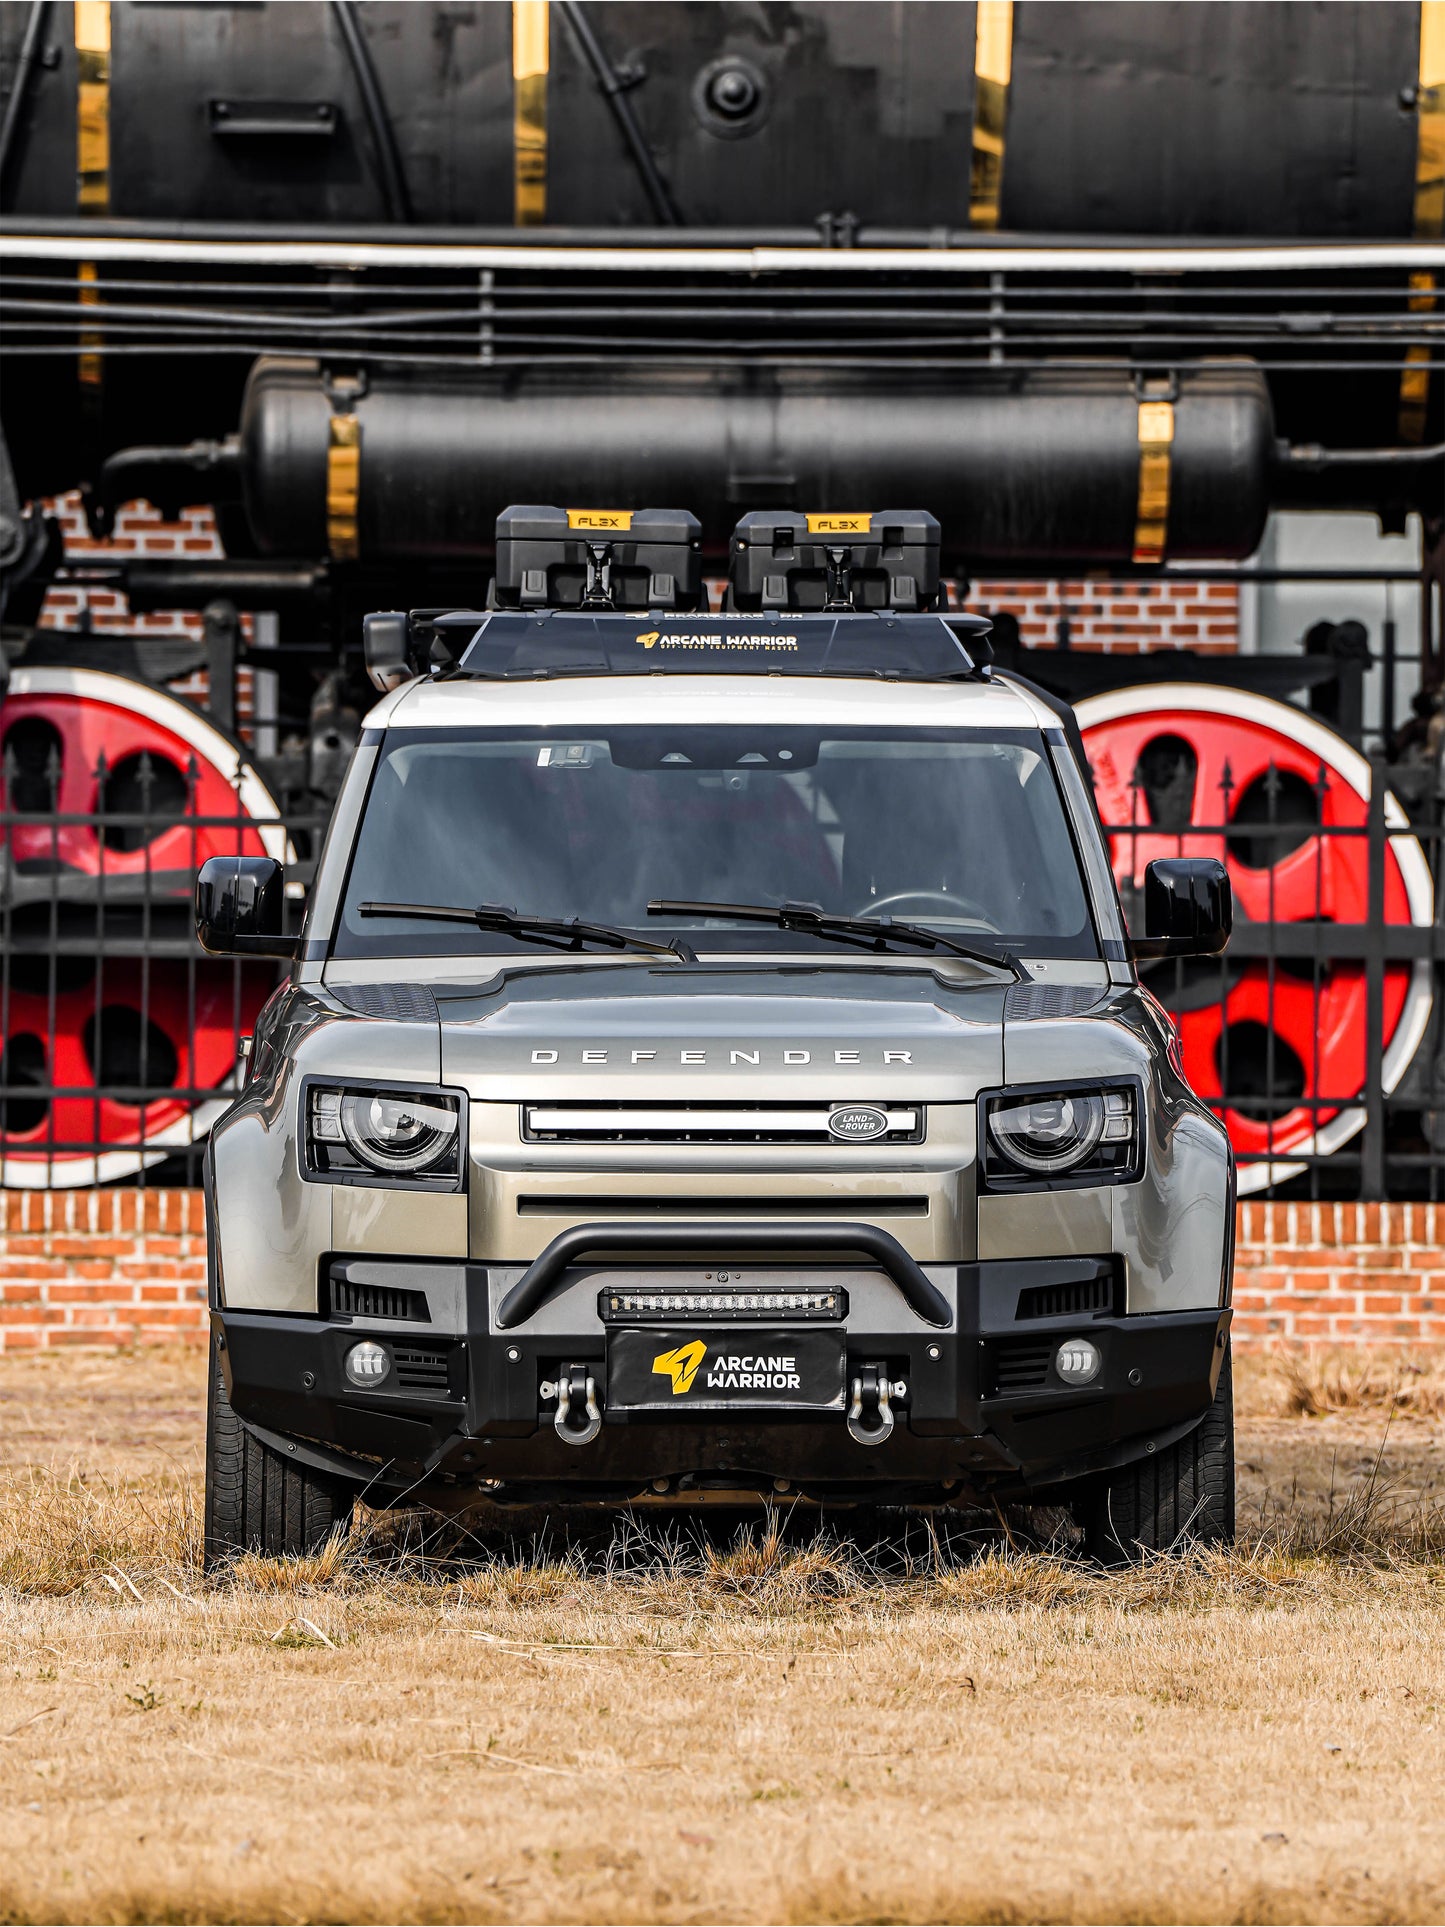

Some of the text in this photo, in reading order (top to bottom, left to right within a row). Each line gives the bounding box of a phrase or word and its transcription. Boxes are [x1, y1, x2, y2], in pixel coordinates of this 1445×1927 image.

[660, 635, 797, 646] ARCANE WARRIOR
[530, 1049, 913, 1065] DEFENDER
[713, 1356, 796, 1371] ARCANE
[707, 1373, 800, 1388] WARRIOR
